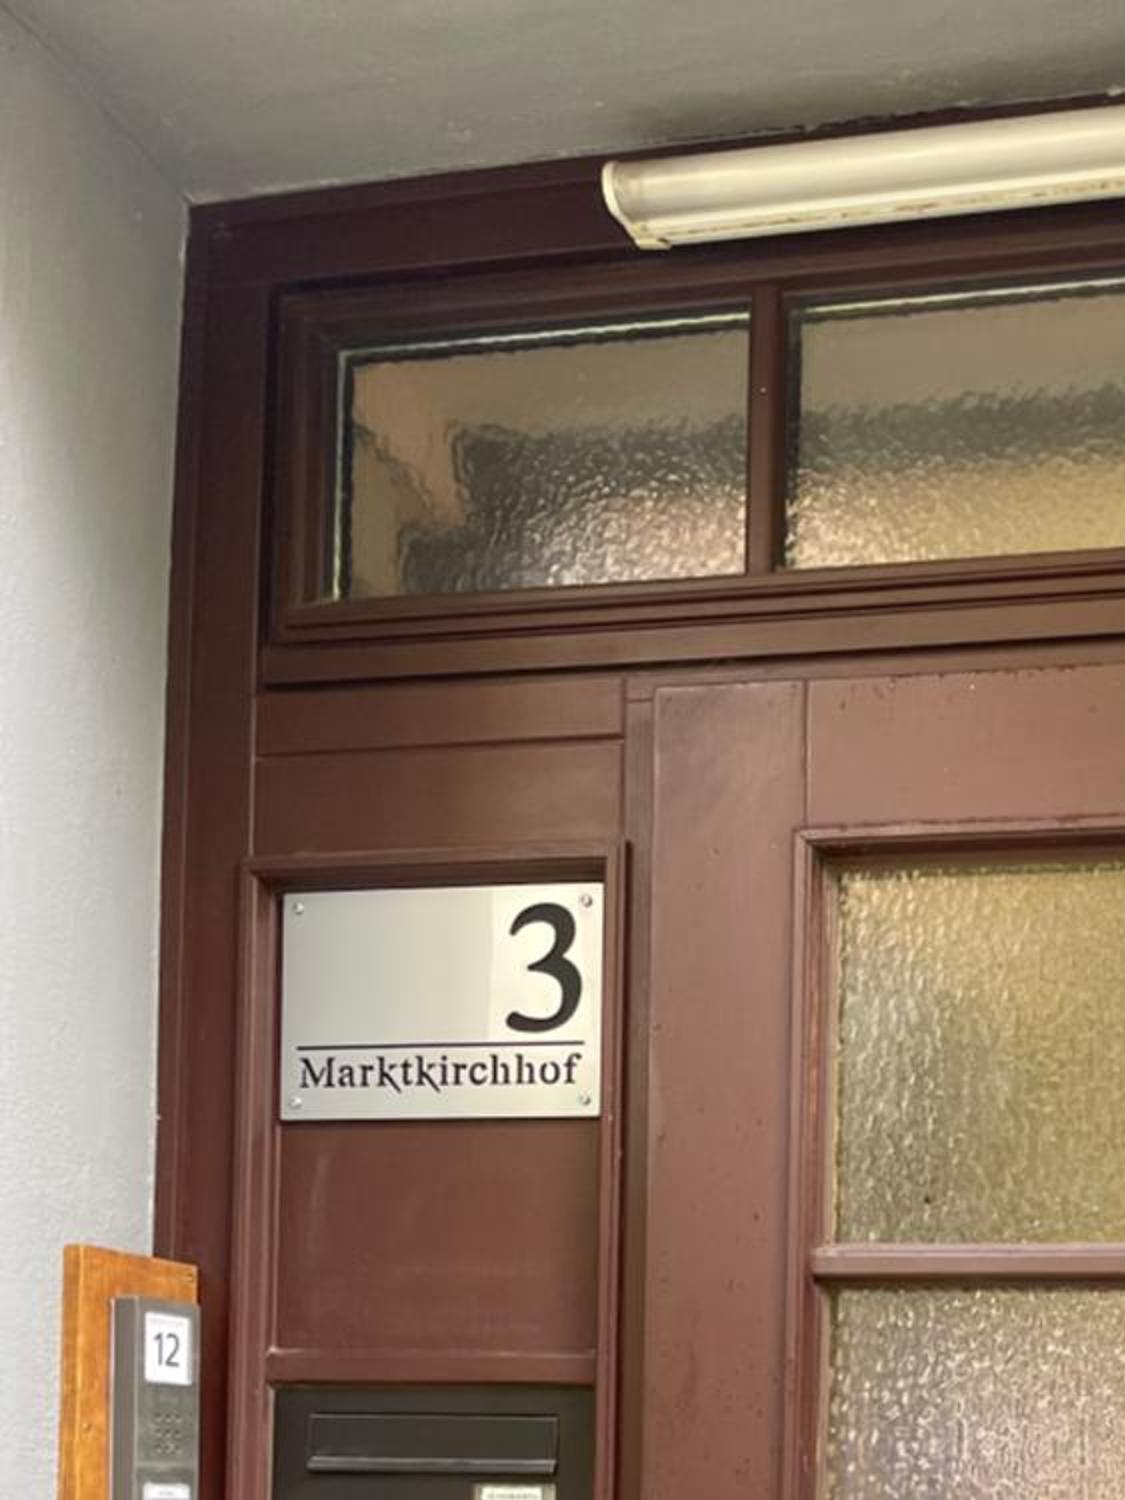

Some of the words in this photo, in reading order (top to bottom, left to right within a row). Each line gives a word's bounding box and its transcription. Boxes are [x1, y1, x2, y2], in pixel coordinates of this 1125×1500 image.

[505, 901, 583, 1033] 3
[299, 1052, 582, 1093] Marktkirchhof
[153, 1331, 180, 1368] 12
